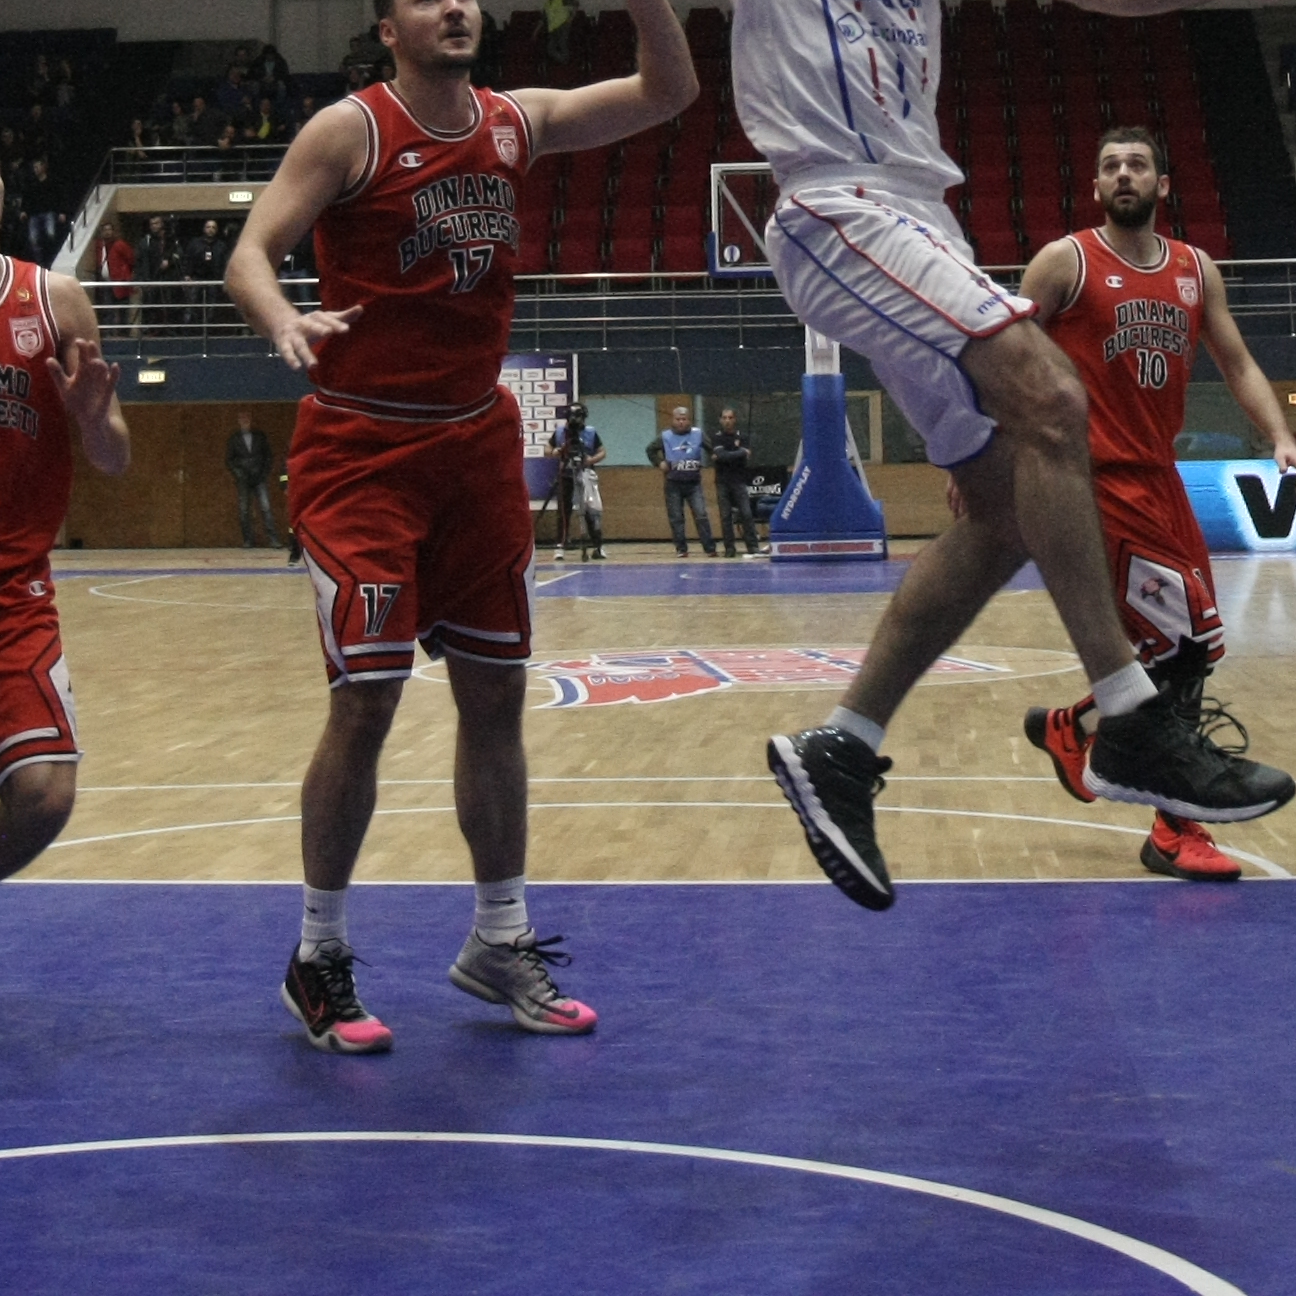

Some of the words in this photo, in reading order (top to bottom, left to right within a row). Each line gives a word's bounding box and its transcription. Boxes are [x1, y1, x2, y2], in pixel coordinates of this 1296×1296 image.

[412, 173, 515, 228] DINAMO
[449, 245, 494, 294] 17
[1115, 299, 1188, 334] DINAMO
[1137, 348, 1168, 390] 10
[359, 584, 402, 636] 17
